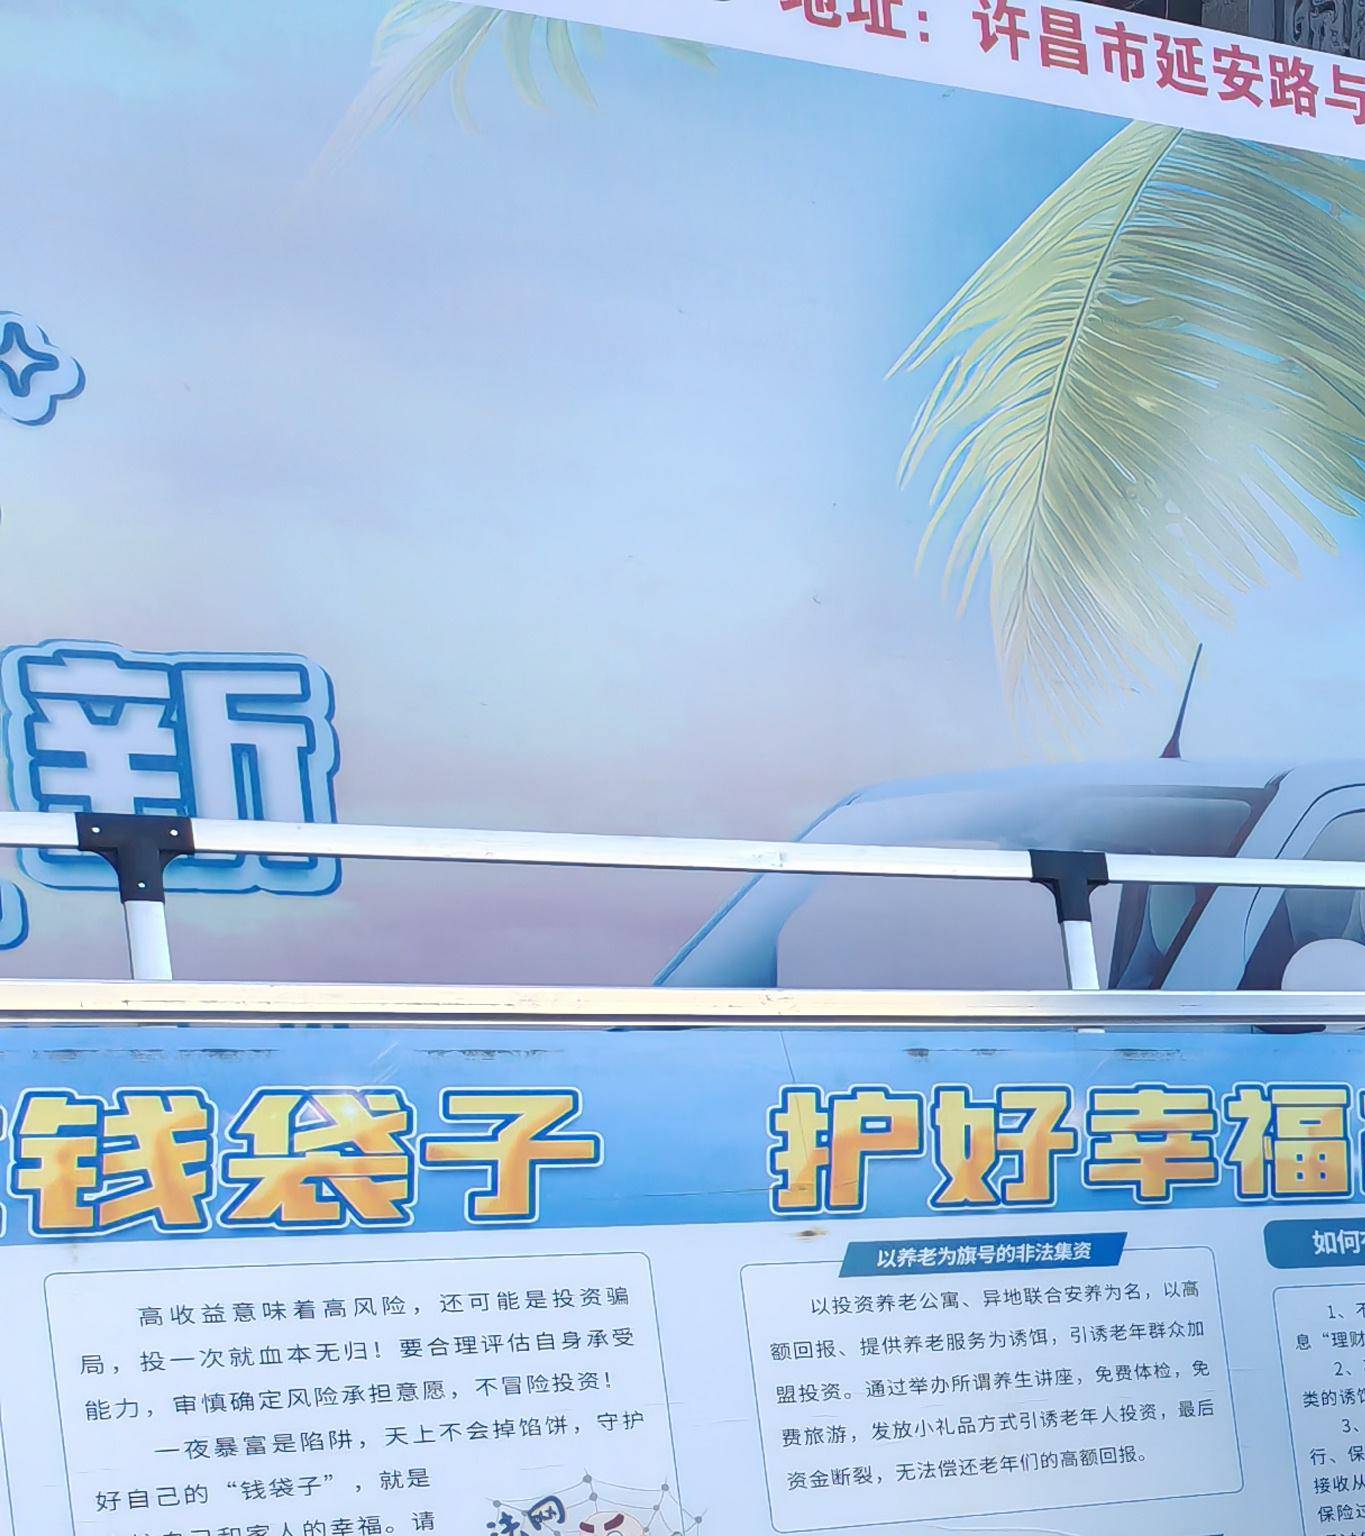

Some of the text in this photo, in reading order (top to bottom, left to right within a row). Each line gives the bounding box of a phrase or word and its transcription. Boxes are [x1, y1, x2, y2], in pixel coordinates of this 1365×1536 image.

[12, 1087, 604, 1234] 钱袋子
[877, 1242, 1091, 1269] 以养老为旗号的非法集资
[138, 1285, 630, 1327] 高收益意味着高风险，还可能是投资骗
[810, 1279, 1199, 1316] 以投资养老公寓、异地联合安养为名，以高
[80, 1327, 636, 1376] 局，投一次就血本无归！要合理评估自身承受
[769, 1319, 1204, 1362] 额回报、提供养老服务为诱饵，引诱老年群众加
[85, 1371, 613, 1422] 能力，审慎确定风险承担意愿，不冒险投资！
[775, 1359, 1210, 1404] 盟投资。通过举办所谓养生讲座，免费体检，免
[153, 1410, 645, 1461] 一夜暴富是陷阱，天上不会掉馅饼，守护
[781, 1398, 1215, 1447] 费旅游，发放小礼品方式引诱老年人投资，最后
[95, 1467, 431, 1513] 好自己的“钱袋子”，就是
[787, 1446, 1148, 1491] 资金断裂，无法偿还老年们的高额回报。
